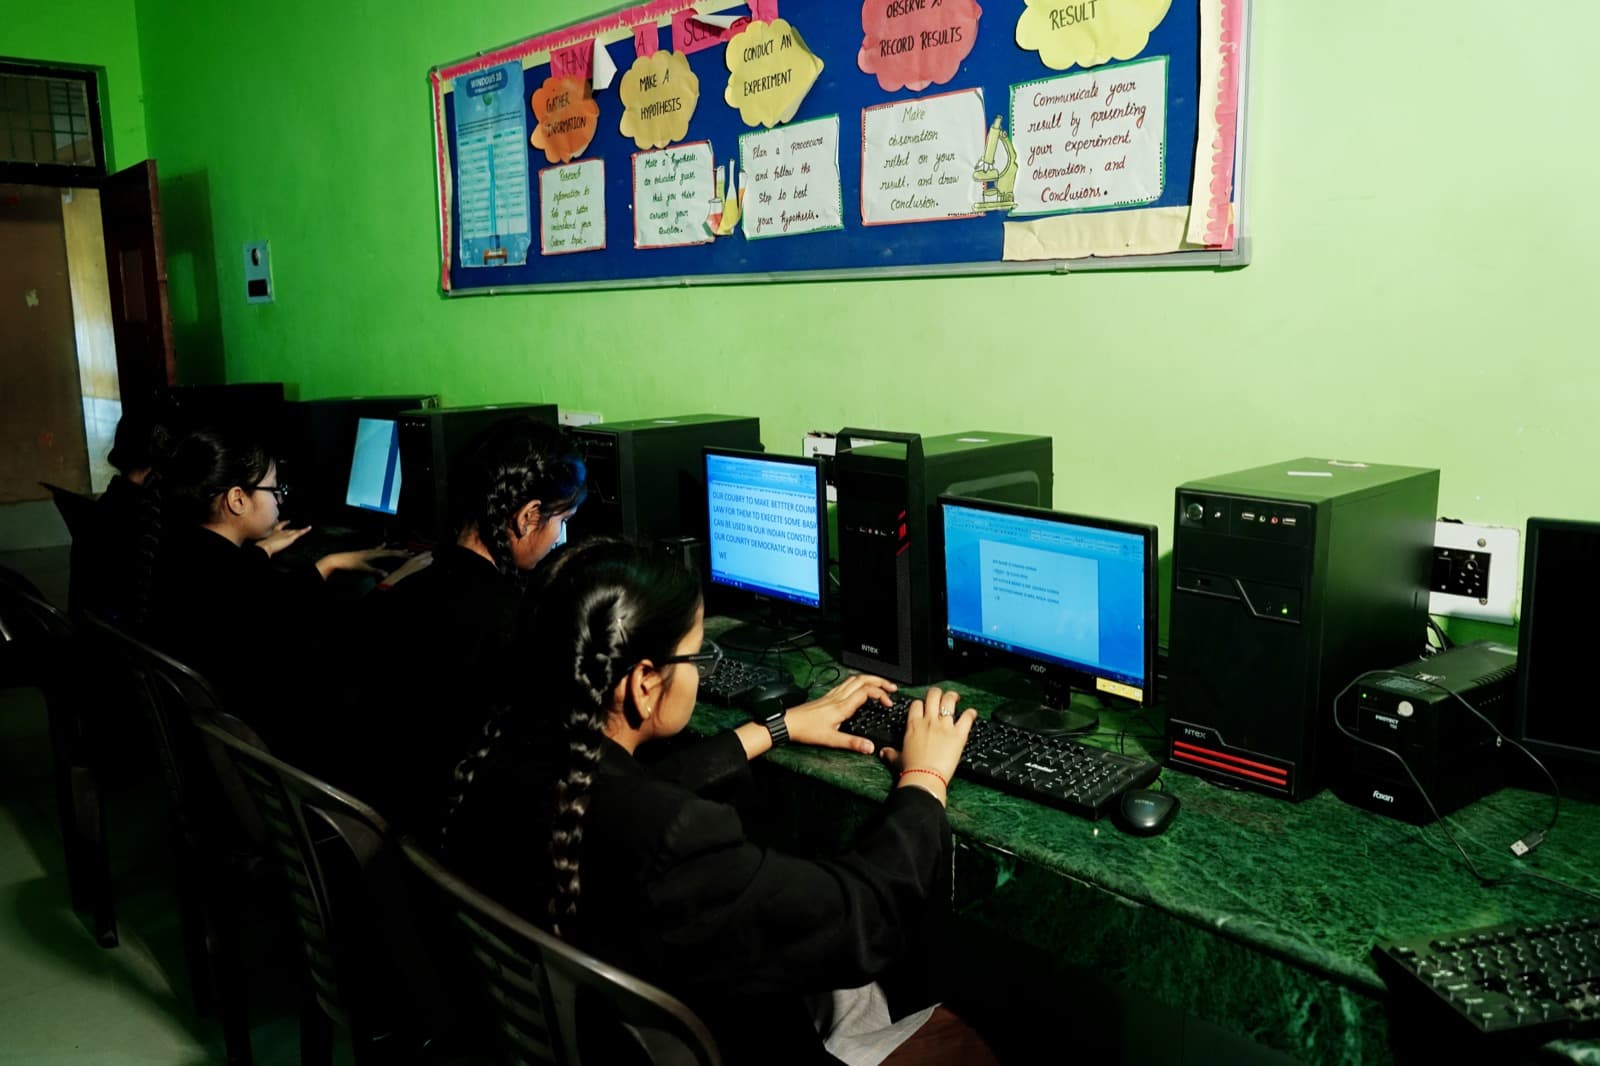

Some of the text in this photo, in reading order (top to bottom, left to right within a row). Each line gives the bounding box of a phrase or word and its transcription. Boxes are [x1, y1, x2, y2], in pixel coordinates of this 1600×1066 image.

[1049, 0, 1097, 31] RESULT
[638, 31, 646, 50] A
[744, 34, 792, 63] CONDUCT AN
[880, 27, 962, 57] RECORD RESULTS
[640, 68, 669, 92] MAKE A
[744, 69, 792, 96] EXPERIMENT
[1033, 80, 1136, 107] Communicate your
[641, 97, 682, 120] HYPOTHESIS
[902, 106, 926, 123] Make
[1027, 102, 1147, 137] result by presenting
[752, 144, 768, 160] Plan
[918, 154, 928, 164] on
[933, 152, 955, 172] your
[1027, 144, 1053, 167] your
[1104, 155, 1126, 172] and
[755, 169, 768, 182] and
[774, 164, 794, 181] follow
[917, 174, 933, 187] and
[756, 216, 773, 233] your
[712, 491, 724, 500] OUR
[746, 495, 754, 504] TO
[754, 498, 770, 509] MAKE
[713, 505, 724, 513] LAW
[725, 506, 735, 515] FOR
[736, 508, 752, 518] THEM
[752, 511, 760, 520] TO
[784, 517, 801, 528] SOME
[802, 520, 817, 530] BASI
[713, 518, 818, 545] CAN BE USED IN OUR INDIAN CONSTITU
[714, 532, 725, 541] OUR
[751, 539, 786, 555] DEMOCRATIC
[787, 544, 794, 555] IN
[794, 548, 808, 559] OUR
